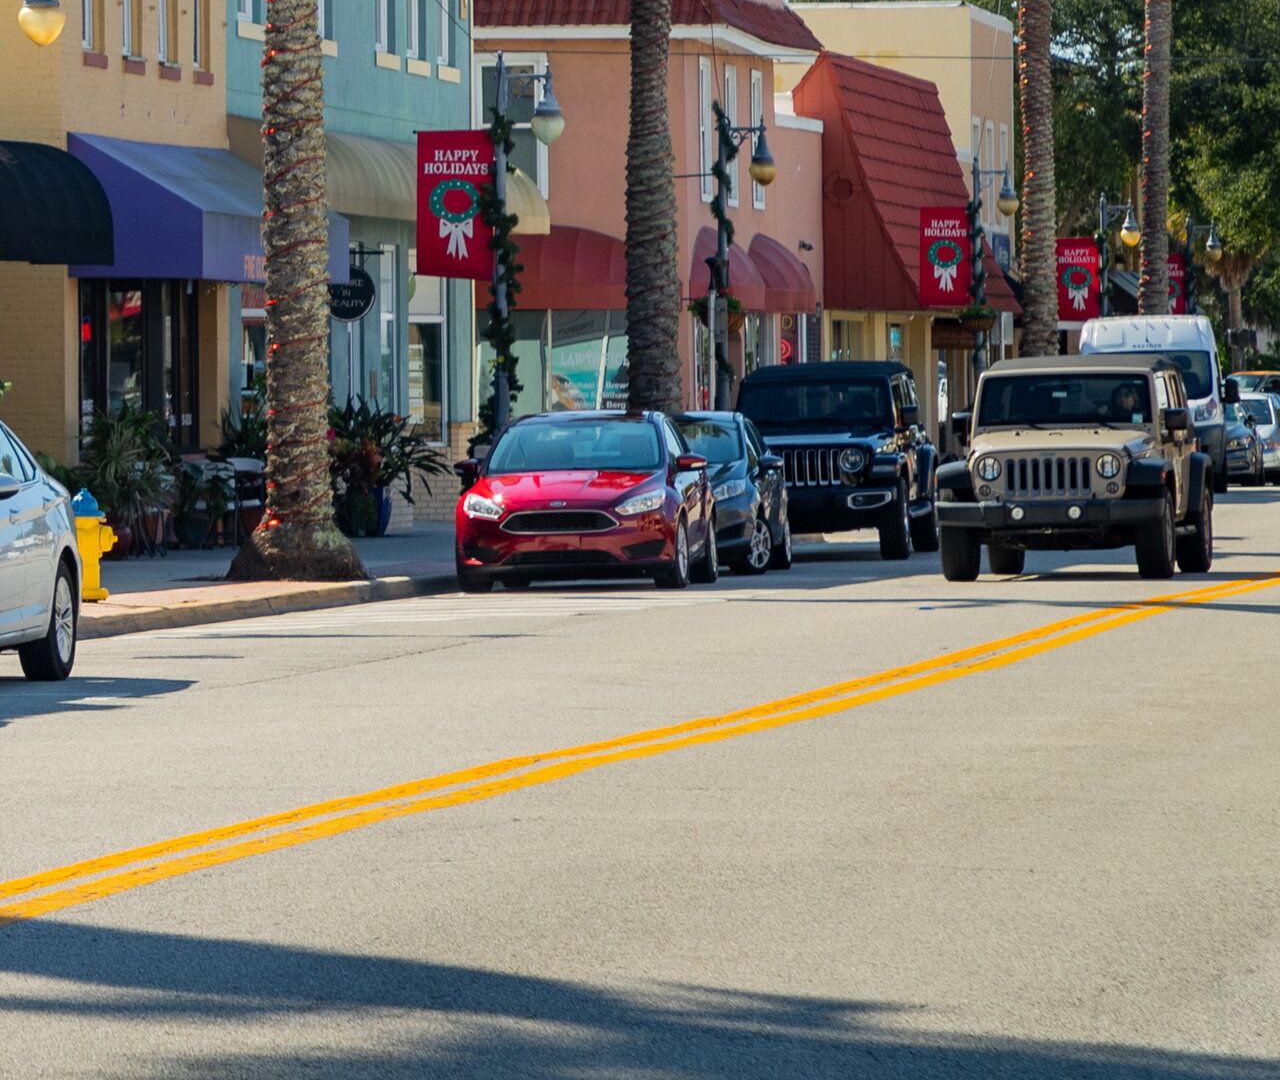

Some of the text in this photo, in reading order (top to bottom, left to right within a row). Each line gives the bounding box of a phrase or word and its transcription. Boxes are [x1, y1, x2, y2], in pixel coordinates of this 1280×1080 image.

[434, 150, 479, 162] HAPPY
[424, 162, 489, 176] HOLIDAYS
[931, 220, 961, 228] HAPPY
[925, 228, 967, 237] HOLIDAYS
[1059, 256, 1096, 264] HOLIDAYS
[560, 352, 584, 367] LAW
[606, 381, 629, 390] Brew
[606, 400, 626, 410] Berg
